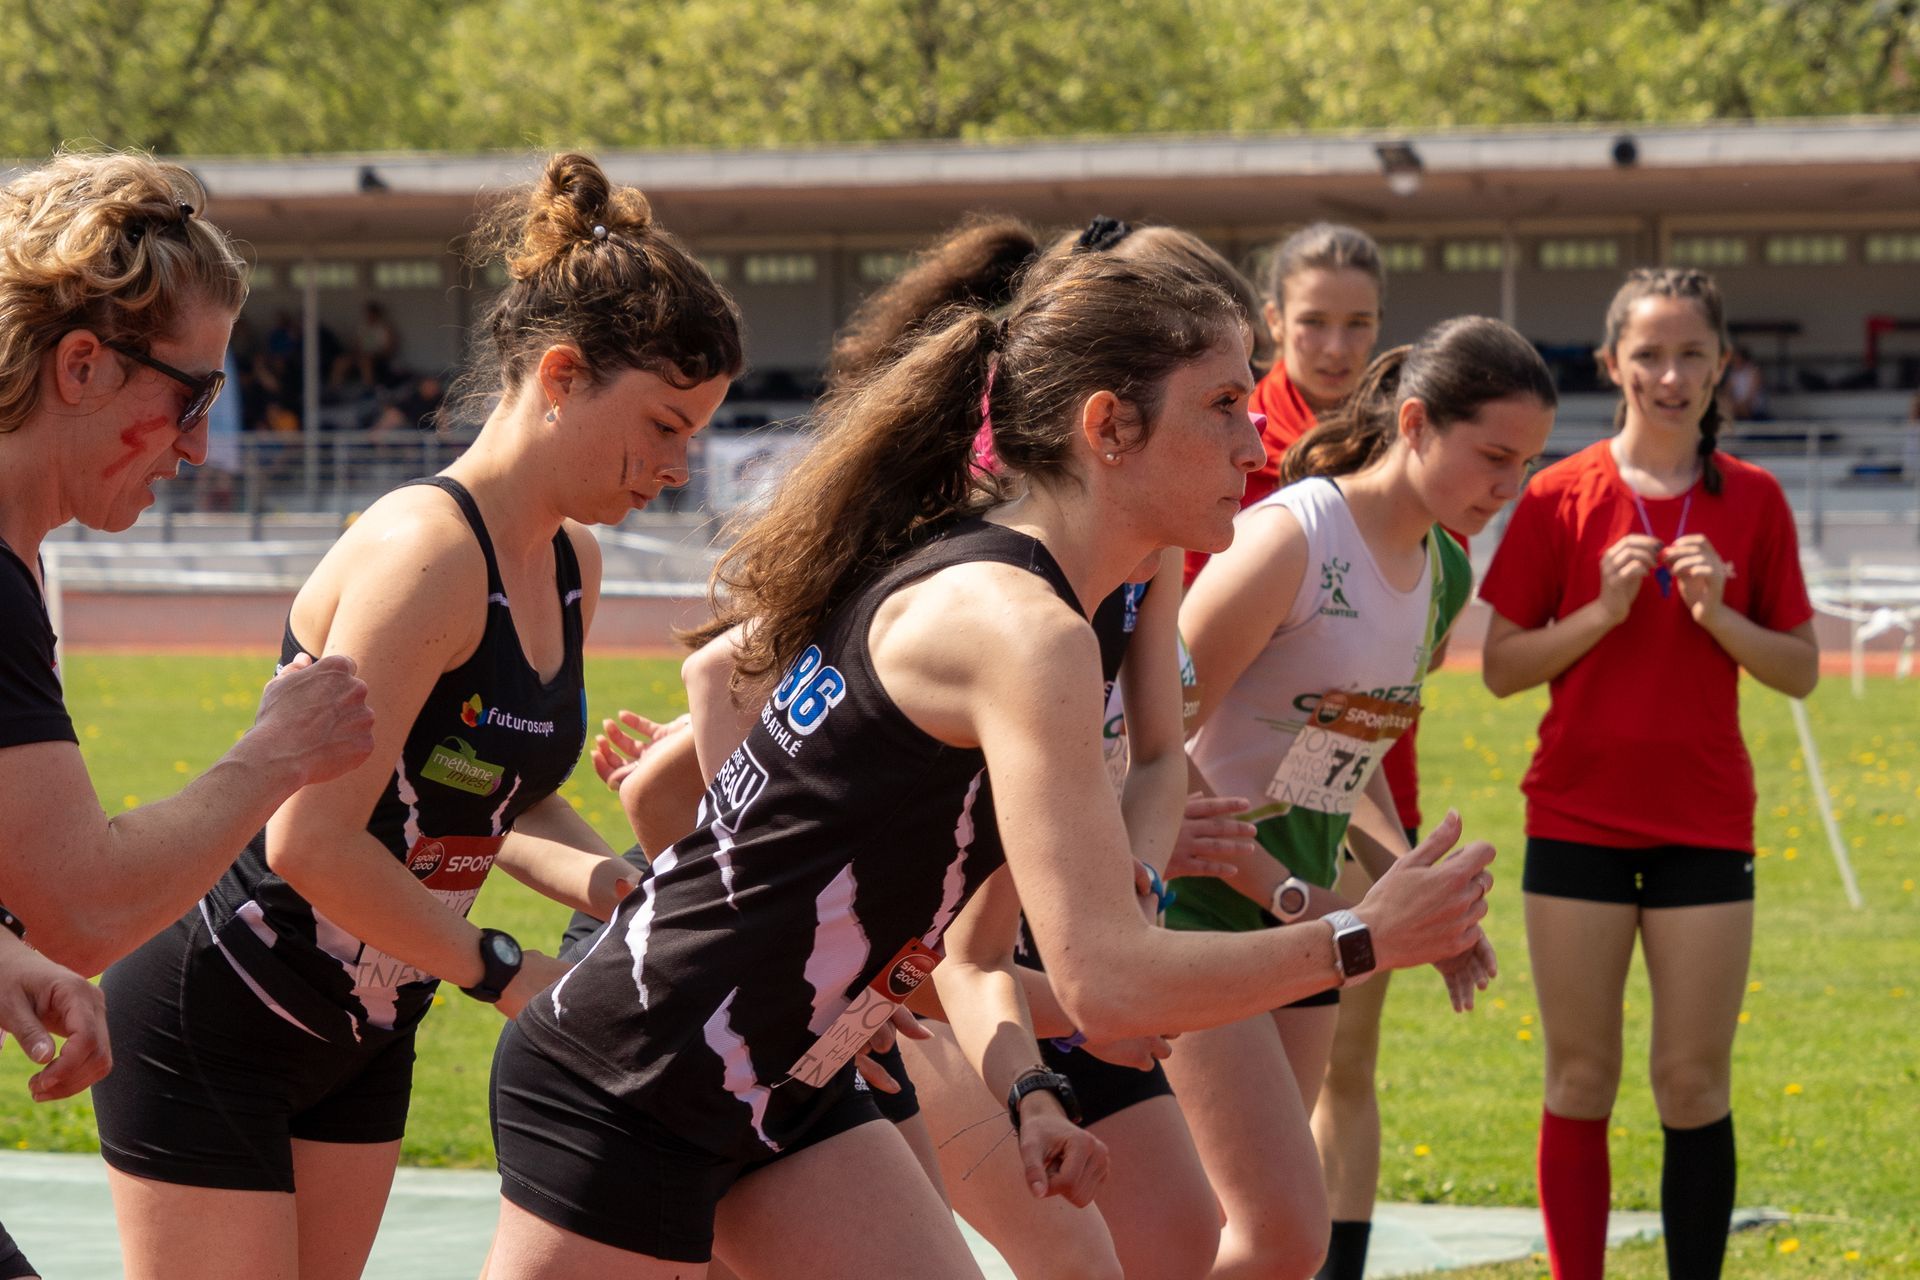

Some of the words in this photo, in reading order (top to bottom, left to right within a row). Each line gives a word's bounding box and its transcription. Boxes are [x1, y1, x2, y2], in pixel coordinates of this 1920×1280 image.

[774, 644, 846, 736] 86
[487, 707, 554, 737] futuroscope
[765, 716, 803, 758] ATHLÉ
[433, 751, 494, 781] méthane
[1323, 749, 1370, 791] 75
[447, 769, 493, 790] invest
[717, 758, 758, 810] REAU
[412, 862, 434, 871] 2000
[414, 853, 441, 864] SPORT
[446, 855, 498, 873] SPOR
[896, 970, 919, 988] 2000
[900, 960, 928, 980] SPORT
